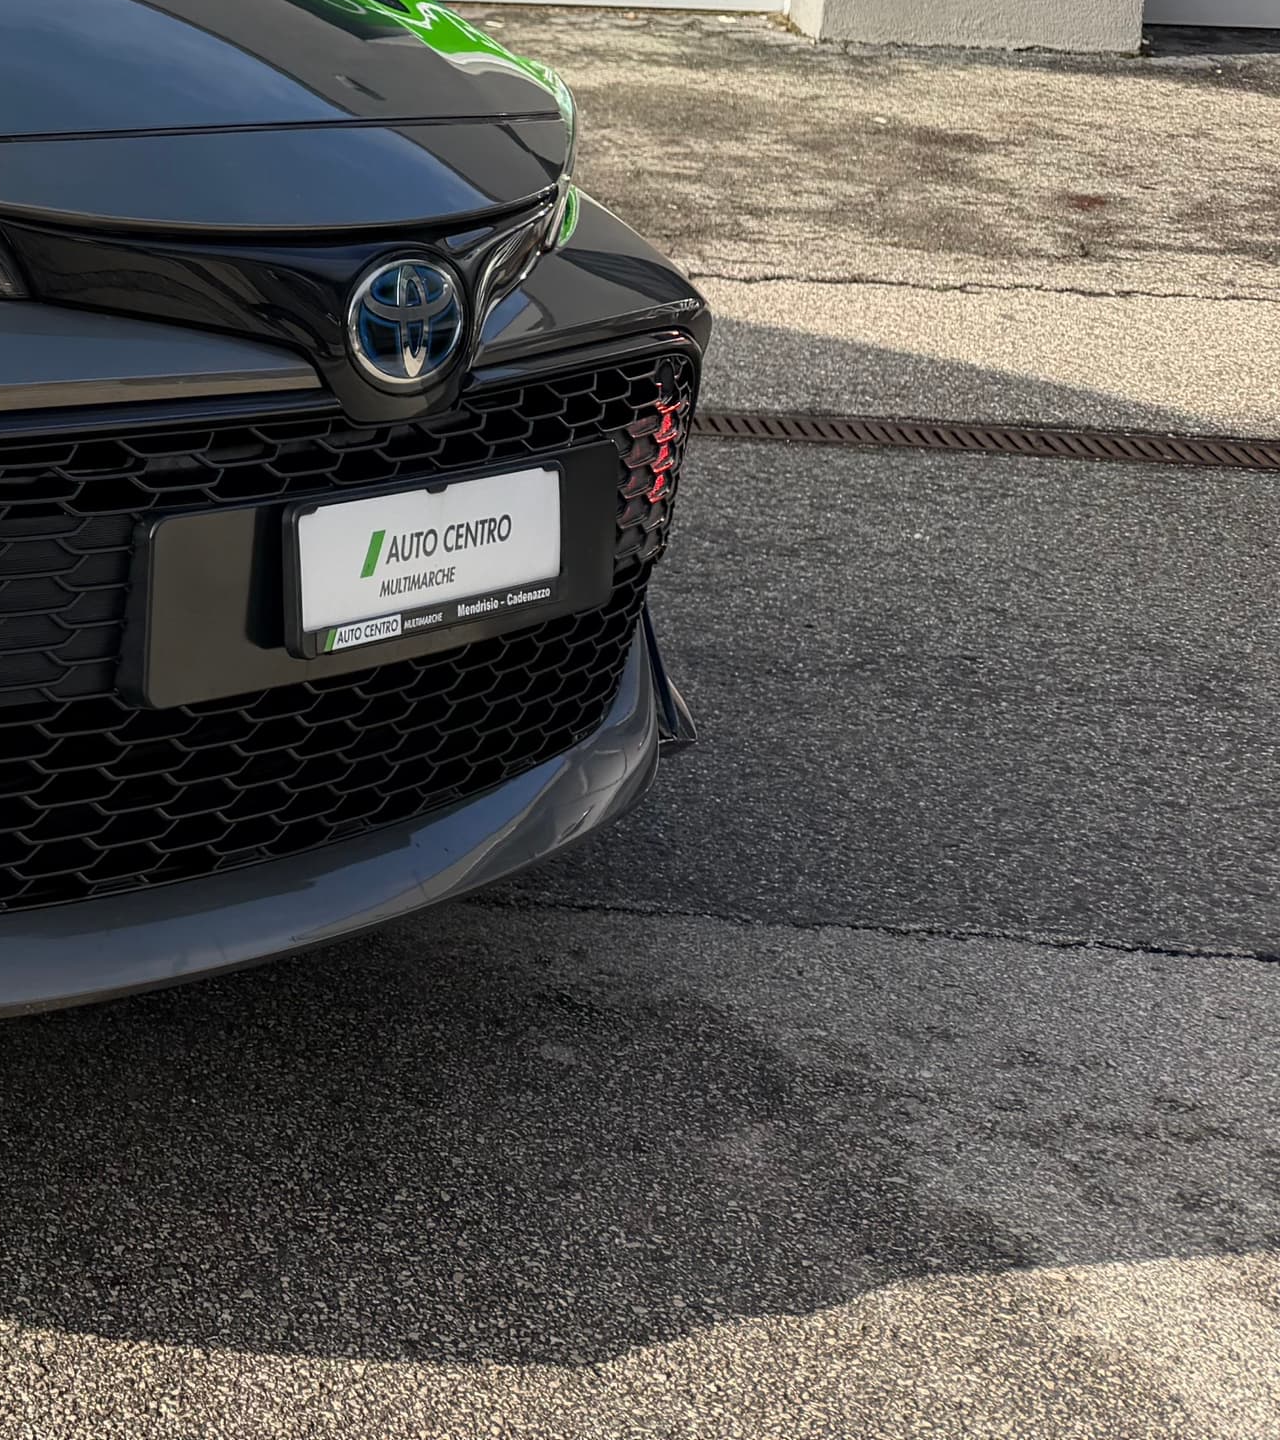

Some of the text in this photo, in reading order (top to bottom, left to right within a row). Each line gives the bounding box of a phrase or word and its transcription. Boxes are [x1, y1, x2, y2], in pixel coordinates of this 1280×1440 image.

[385, 514, 512, 564] AUTO CENTRO
[380, 567, 456, 597] MULTIMARCHE
[336, 627, 362, 645] AUTO
[364, 618, 399, 639] CENTRO
[404, 612, 443, 629] MULTIMARCHE
[457, 599, 499, 618] Mendrisio
[506, 587, 551, 606] Cadenazzo
